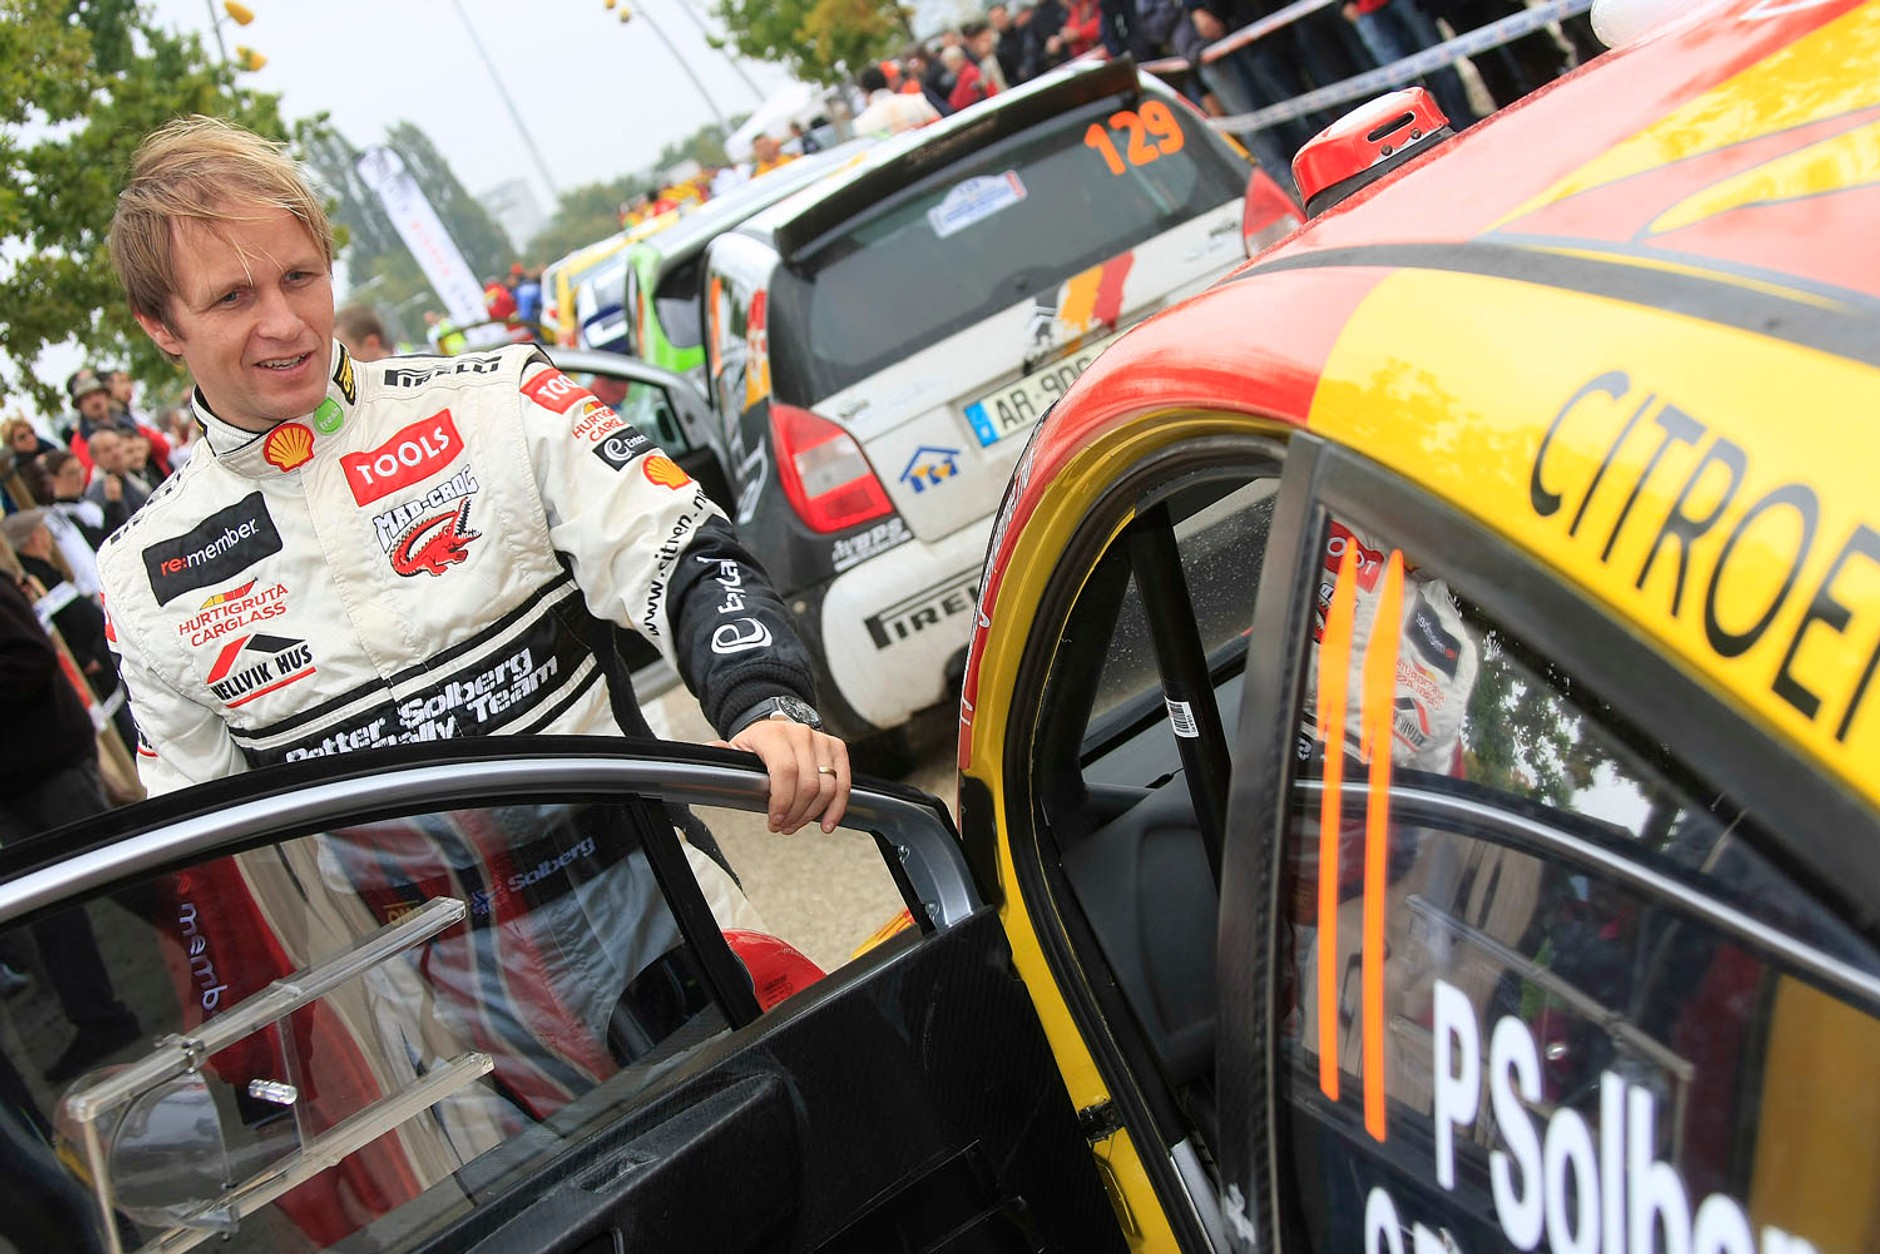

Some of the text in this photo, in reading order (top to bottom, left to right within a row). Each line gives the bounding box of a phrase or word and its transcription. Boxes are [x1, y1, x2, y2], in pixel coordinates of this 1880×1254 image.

[1084, 100, 1184, 175] 129
[996, 389, 1036, 429] AR
[356, 426, 449, 485] TOOLS
[373, 463, 480, 553] MAD-CROC
[160, 518, 259, 577] re:member
[1530, 370, 1880, 744] CITROE
[179, 583, 289, 635] HURTIGRUTA
[191, 602, 287, 648] CARGLASS
[275, 645, 313, 675] HUS
[398, 647, 533, 730] Solberg
[466, 655, 558, 723] Team
[508, 836, 597, 892] Solberg
